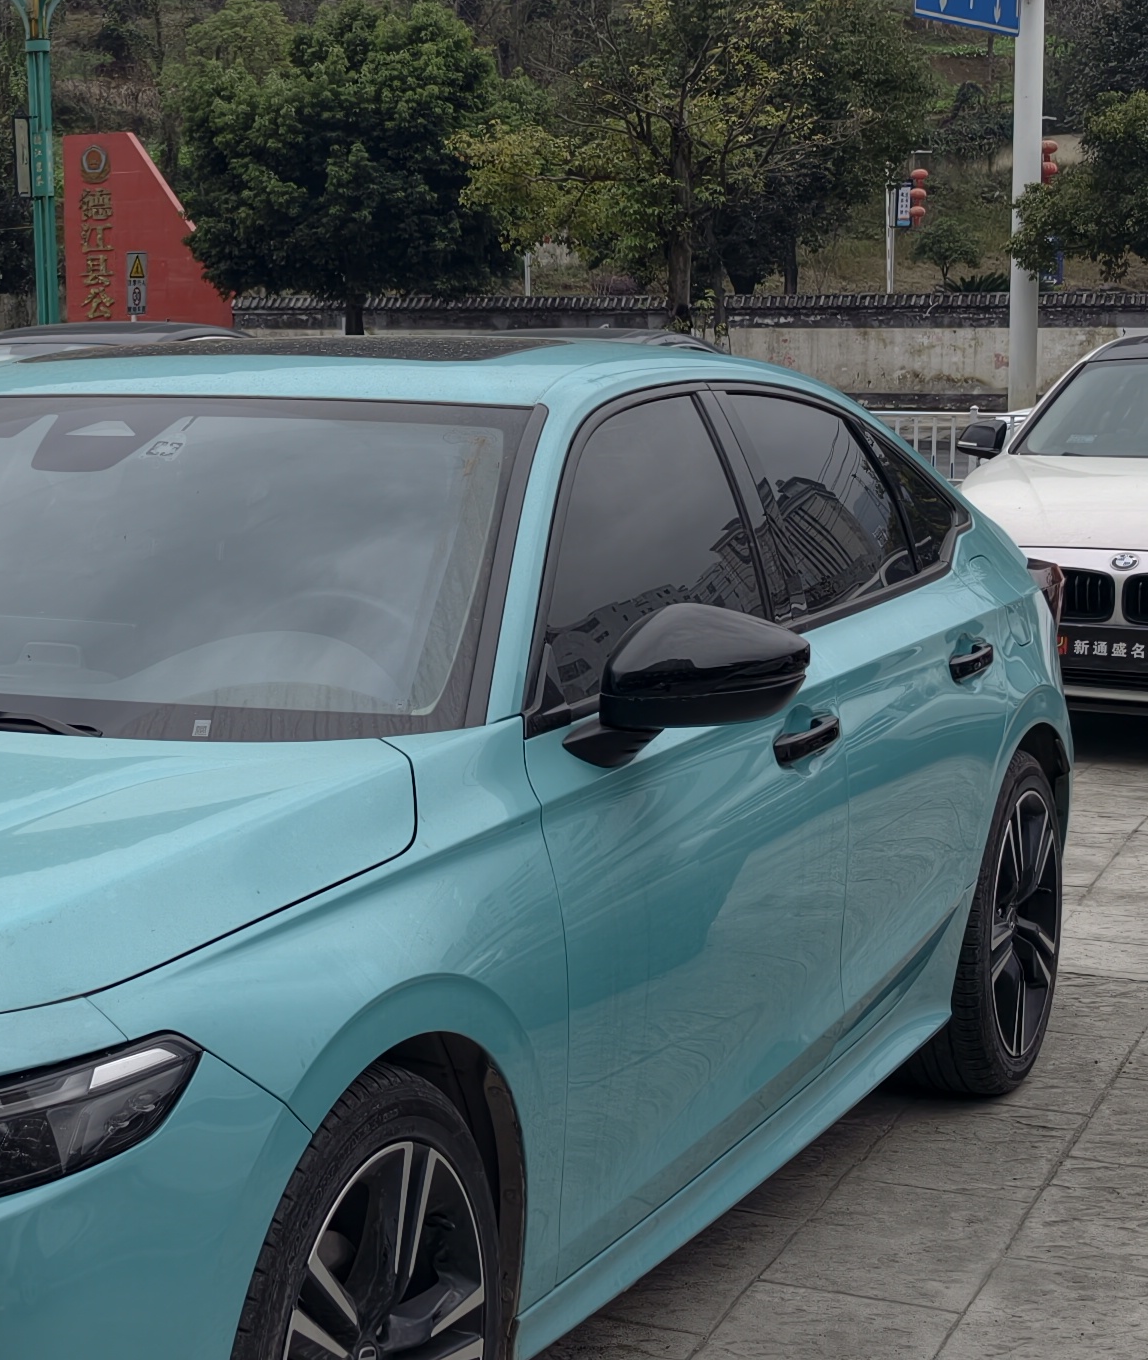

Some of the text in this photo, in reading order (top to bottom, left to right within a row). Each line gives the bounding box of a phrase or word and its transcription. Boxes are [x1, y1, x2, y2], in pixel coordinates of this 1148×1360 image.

[79, 188, 116, 321] 德江县公
[1073, 639, 1145, 659] 新通盛名
